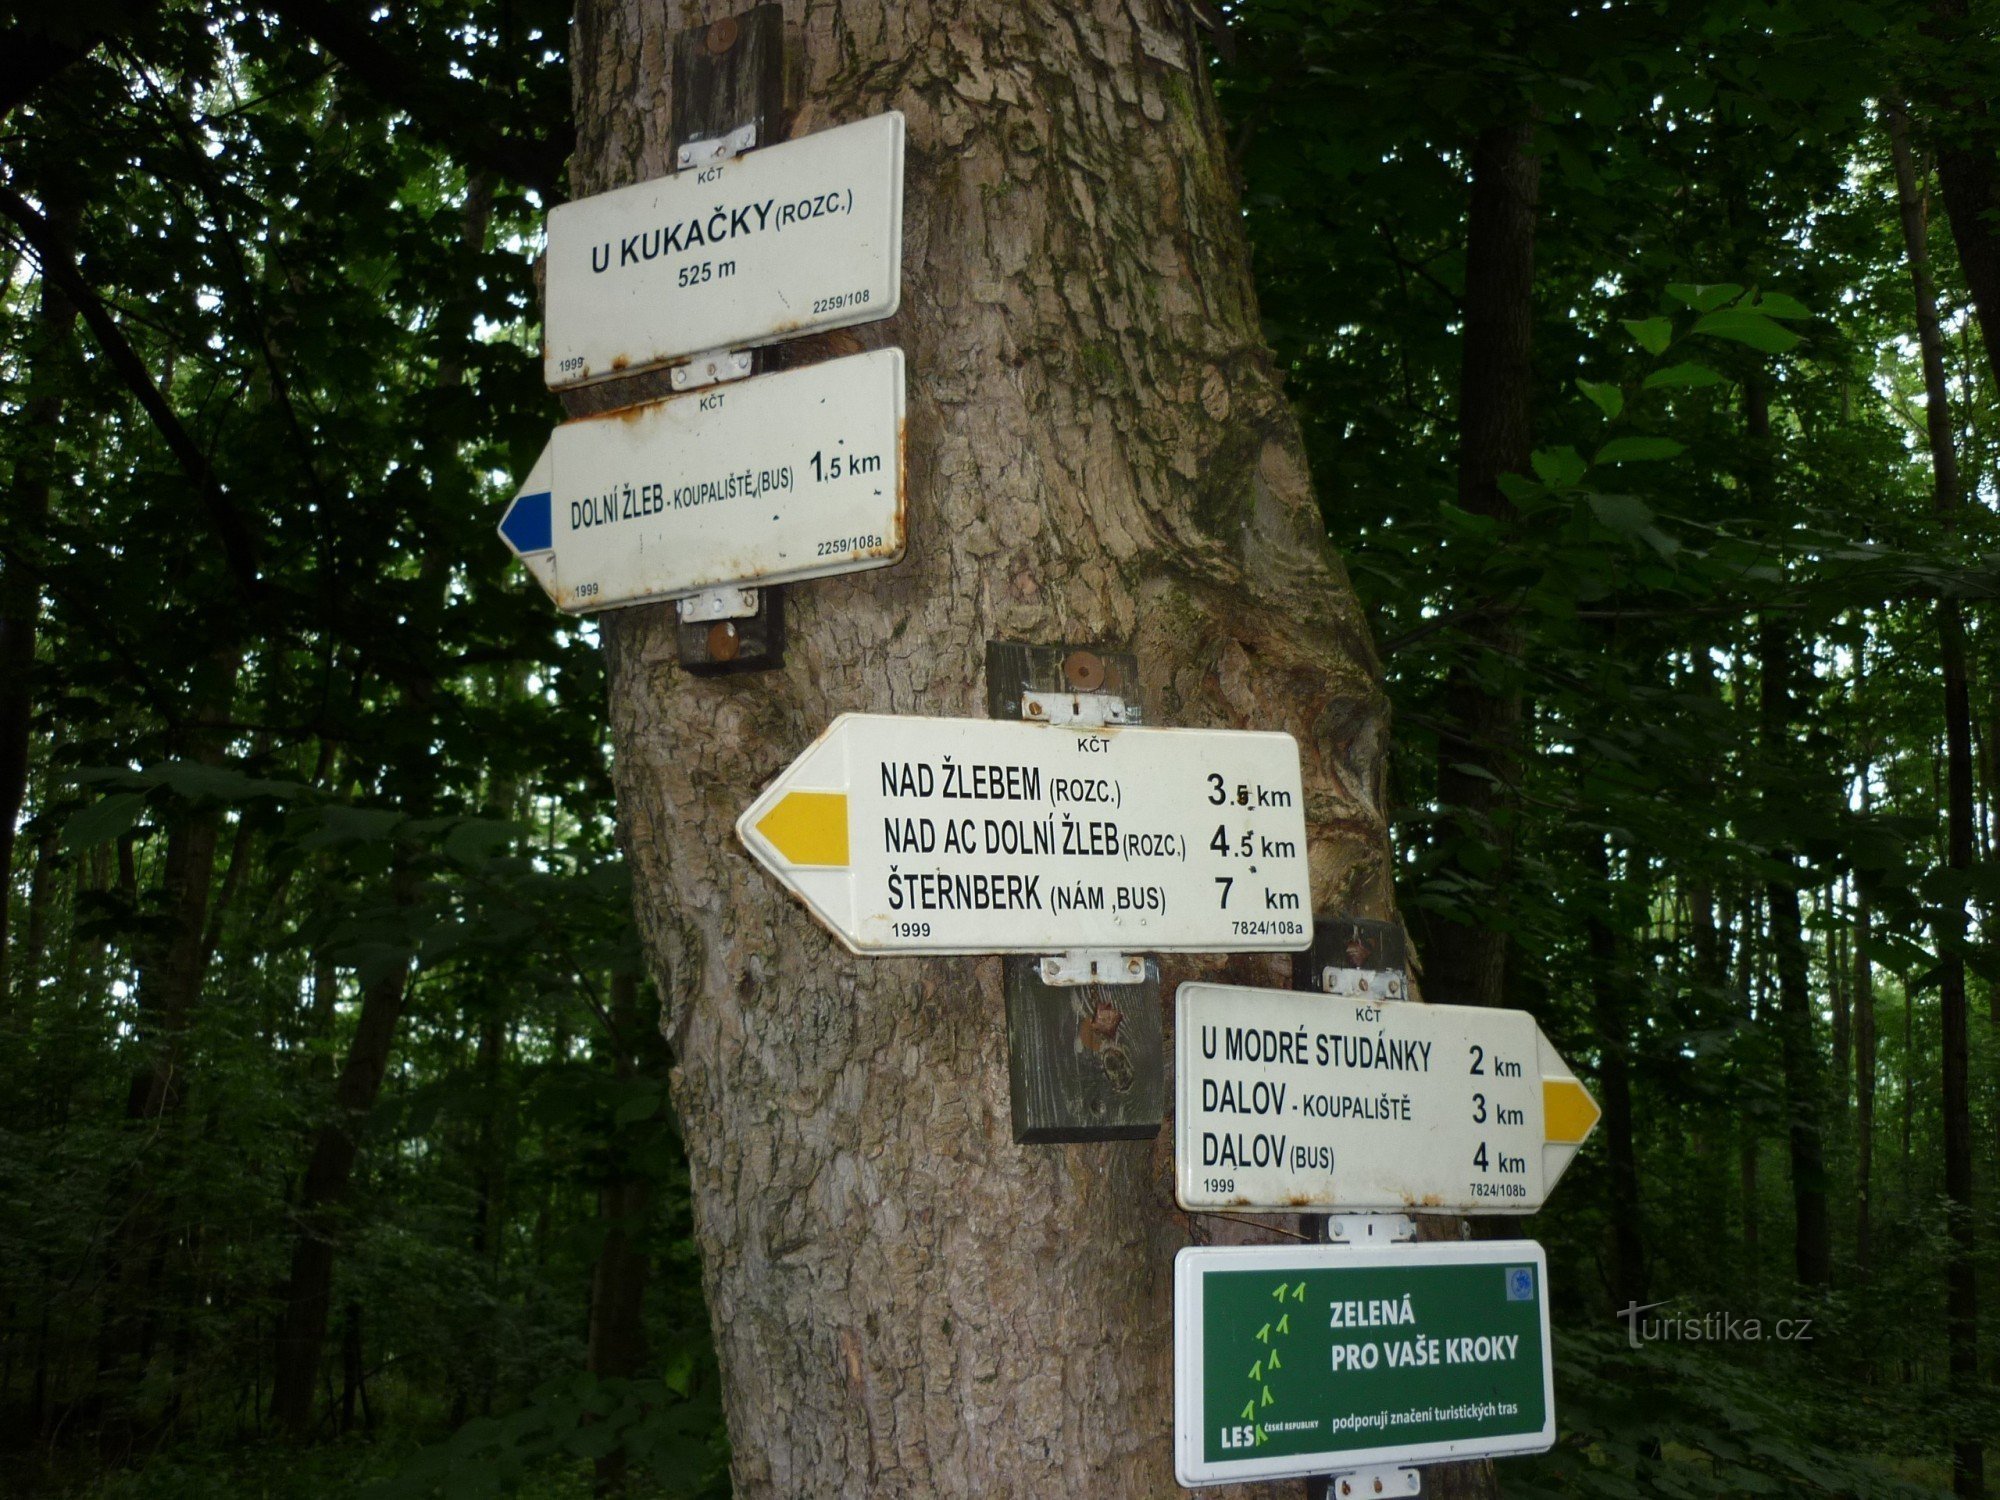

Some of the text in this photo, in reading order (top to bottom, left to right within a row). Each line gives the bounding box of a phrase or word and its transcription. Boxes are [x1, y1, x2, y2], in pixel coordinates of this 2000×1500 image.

[697, 167, 724, 185] KČT
[592, 189, 853, 274] U KUKAČKY (ROZC.)
[678, 260, 736, 288] 525 m
[812, 289, 870, 315] 2259/108
[558, 356, 584, 372] 1999
[699, 395, 725, 413] KČT
[849, 454, 881, 476] km
[571, 486, 619, 530] DOLNÍ
[622, 483, 664, 520] ŽLEB
[757, 466, 794, 499] (BUS)
[816, 535, 883, 557] 2259/108a
[575, 583, 600, 598] 1999
[1077, 738, 1110, 754] KČT
[881, 761, 934, 799] NAD
[942, 755, 1041, 801] ŽLEBEM
[1049, 776, 1122, 808] (ROZC.)
[1257, 784, 1292, 808] km
[884, 817, 934, 855] NAD
[944, 819, 977, 855] AC
[984, 811, 1056, 857] DOLNÍ
[1062, 812, 1120, 857] ŽLEB
[1209, 824, 1254, 859] 4.5
[1261, 835, 1296, 859] km
[887, 864, 1043, 911] ŠTERNBERK
[1214, 876, 1234, 910] 7
[1264, 886, 1300, 910] km
[891, 921, 1304, 938] 1999 7824/108a
[1355, 1008, 1381, 1023] KČT
[1201, 1025, 1522, 1078] U MODRÉ STUDÁNKY 2 km
[1202, 1078, 1286, 1115] DALOV
[1303, 1094, 1412, 1121] KOUPALIŠTĚ
[1472, 1093, 1487, 1124] 3
[1497, 1104, 1524, 1126] km
[1202, 1132, 1525, 1175] DALOV (BUS) 4 km
[1203, 1178, 1527, 1197] 1999 7824/108b
[1330, 1293, 1416, 1328] ZELENÁ
[1331, 1334, 1520, 1371] PRO VAŠE KROKY
[1284, 1420, 1319, 1431] REPUBLIKY
[1332, 1402, 1518, 1434] podporují značení turistických tras
